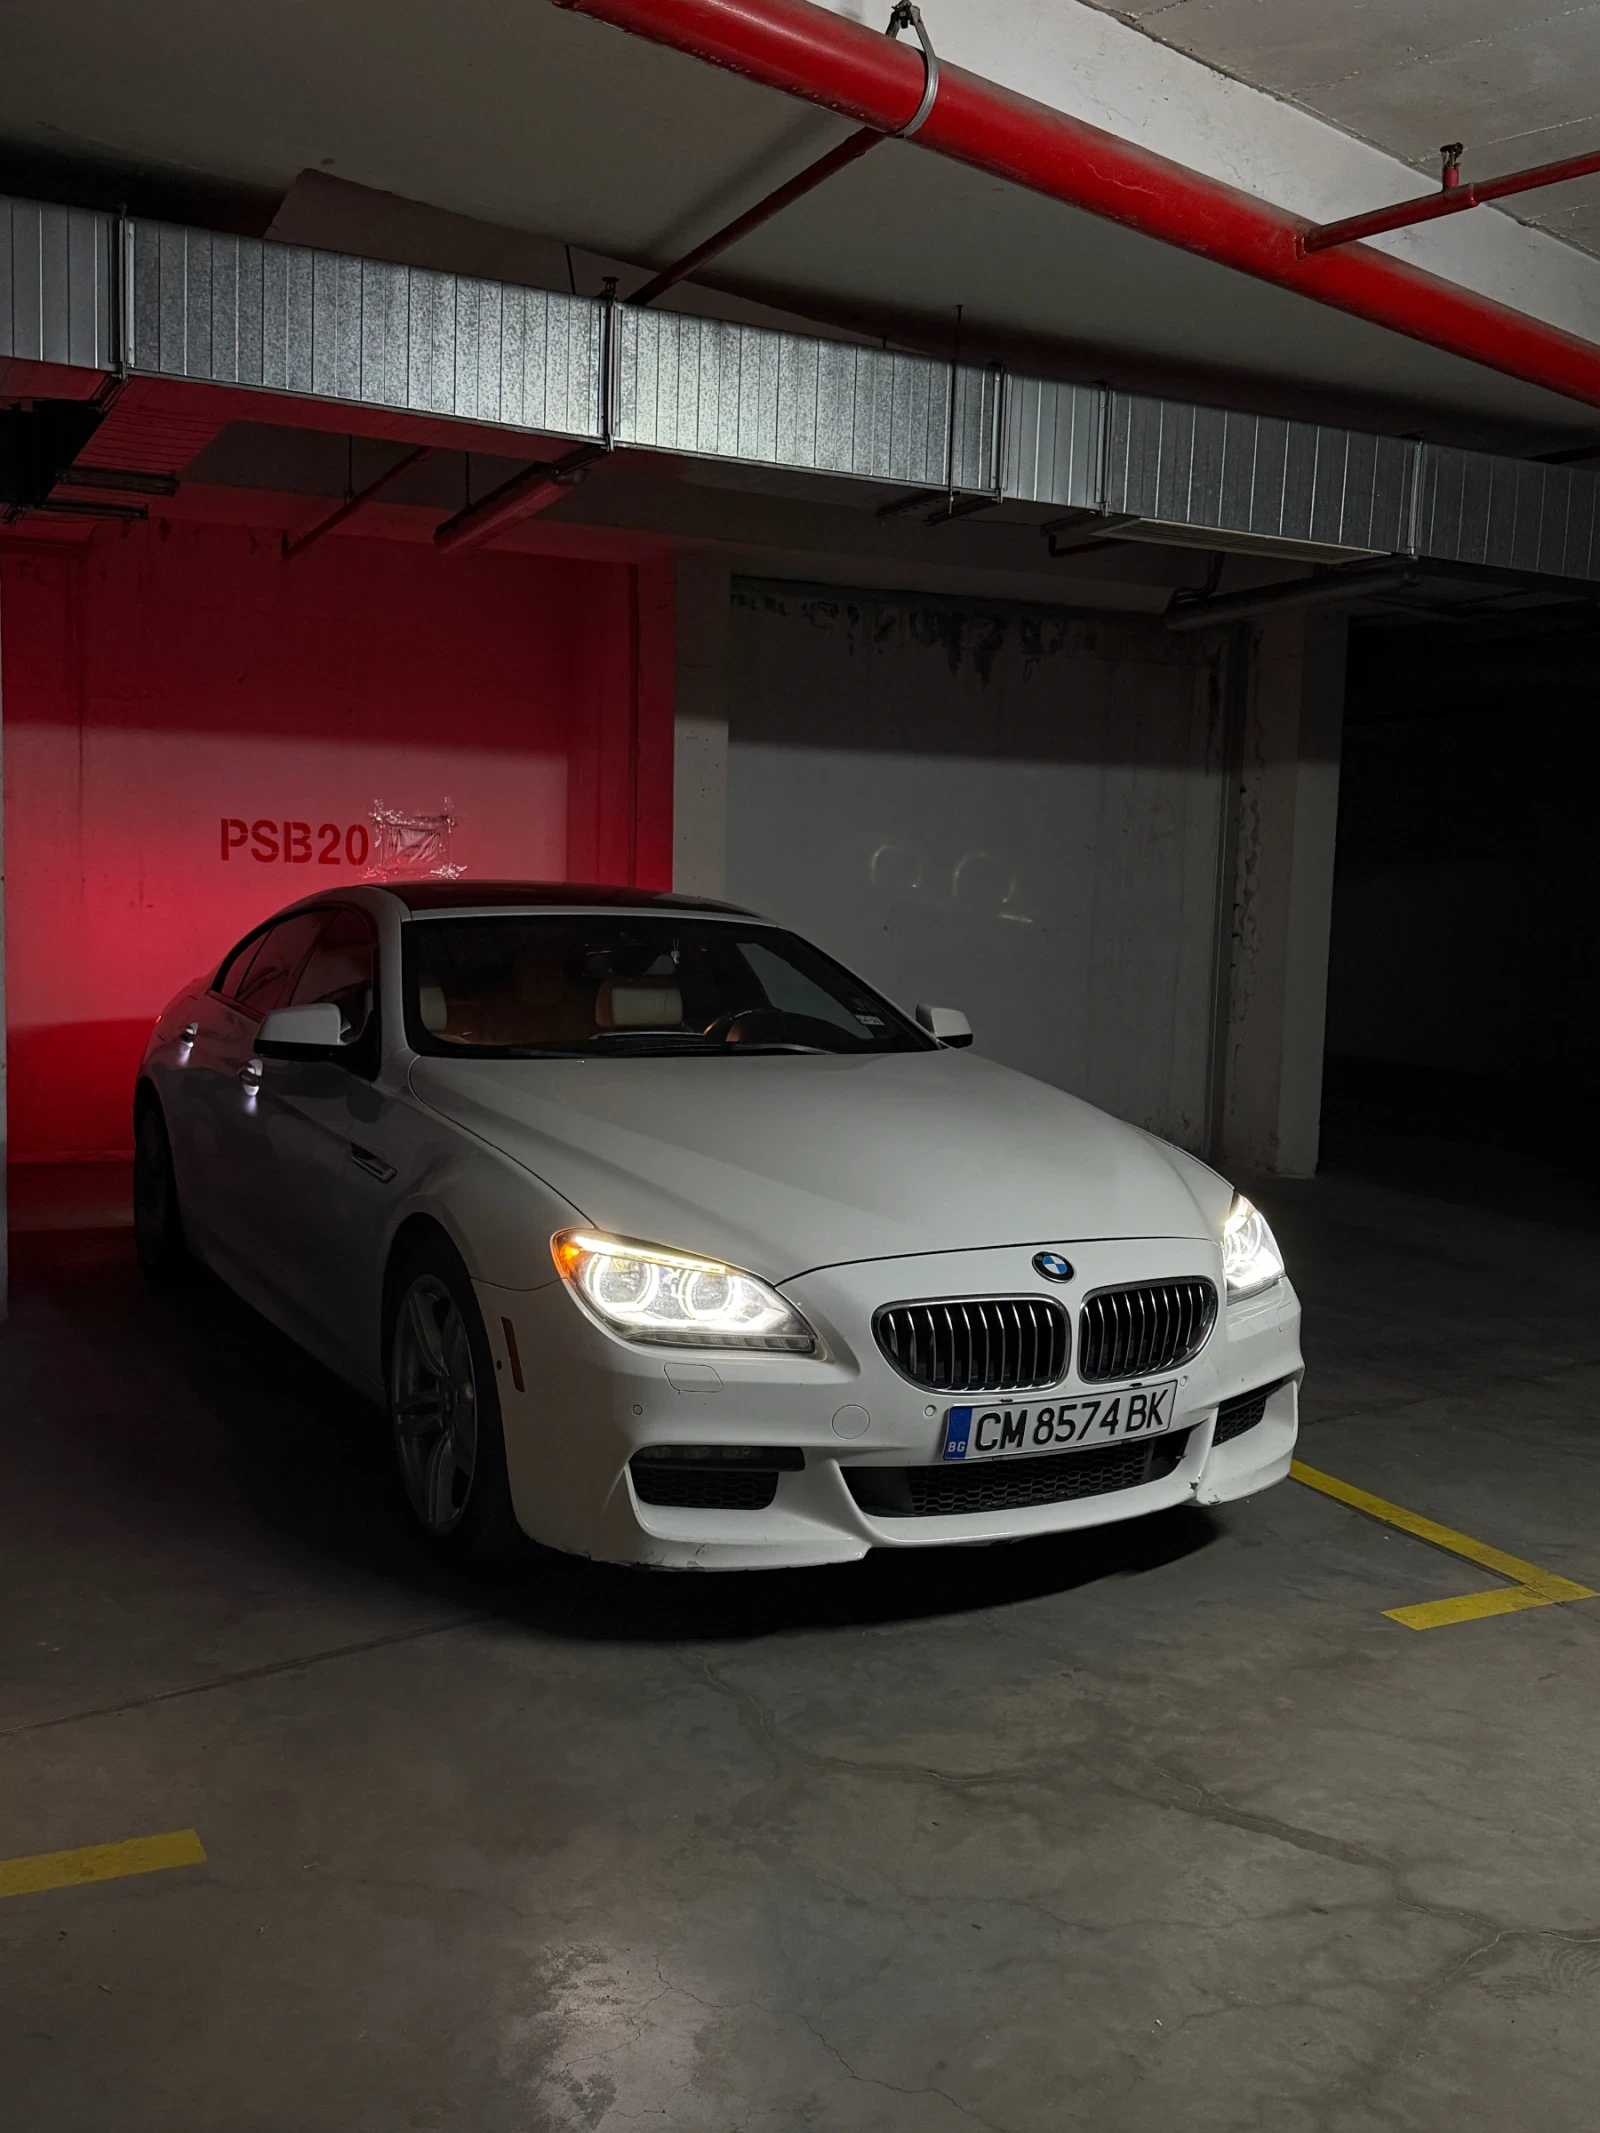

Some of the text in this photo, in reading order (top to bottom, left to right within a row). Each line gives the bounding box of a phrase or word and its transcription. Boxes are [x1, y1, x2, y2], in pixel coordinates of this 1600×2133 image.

[220, 818, 369, 865] PSB20
[974, 1388, 1169, 1451] CM 8574 BK
[948, 1441, 966, 1452] BG
